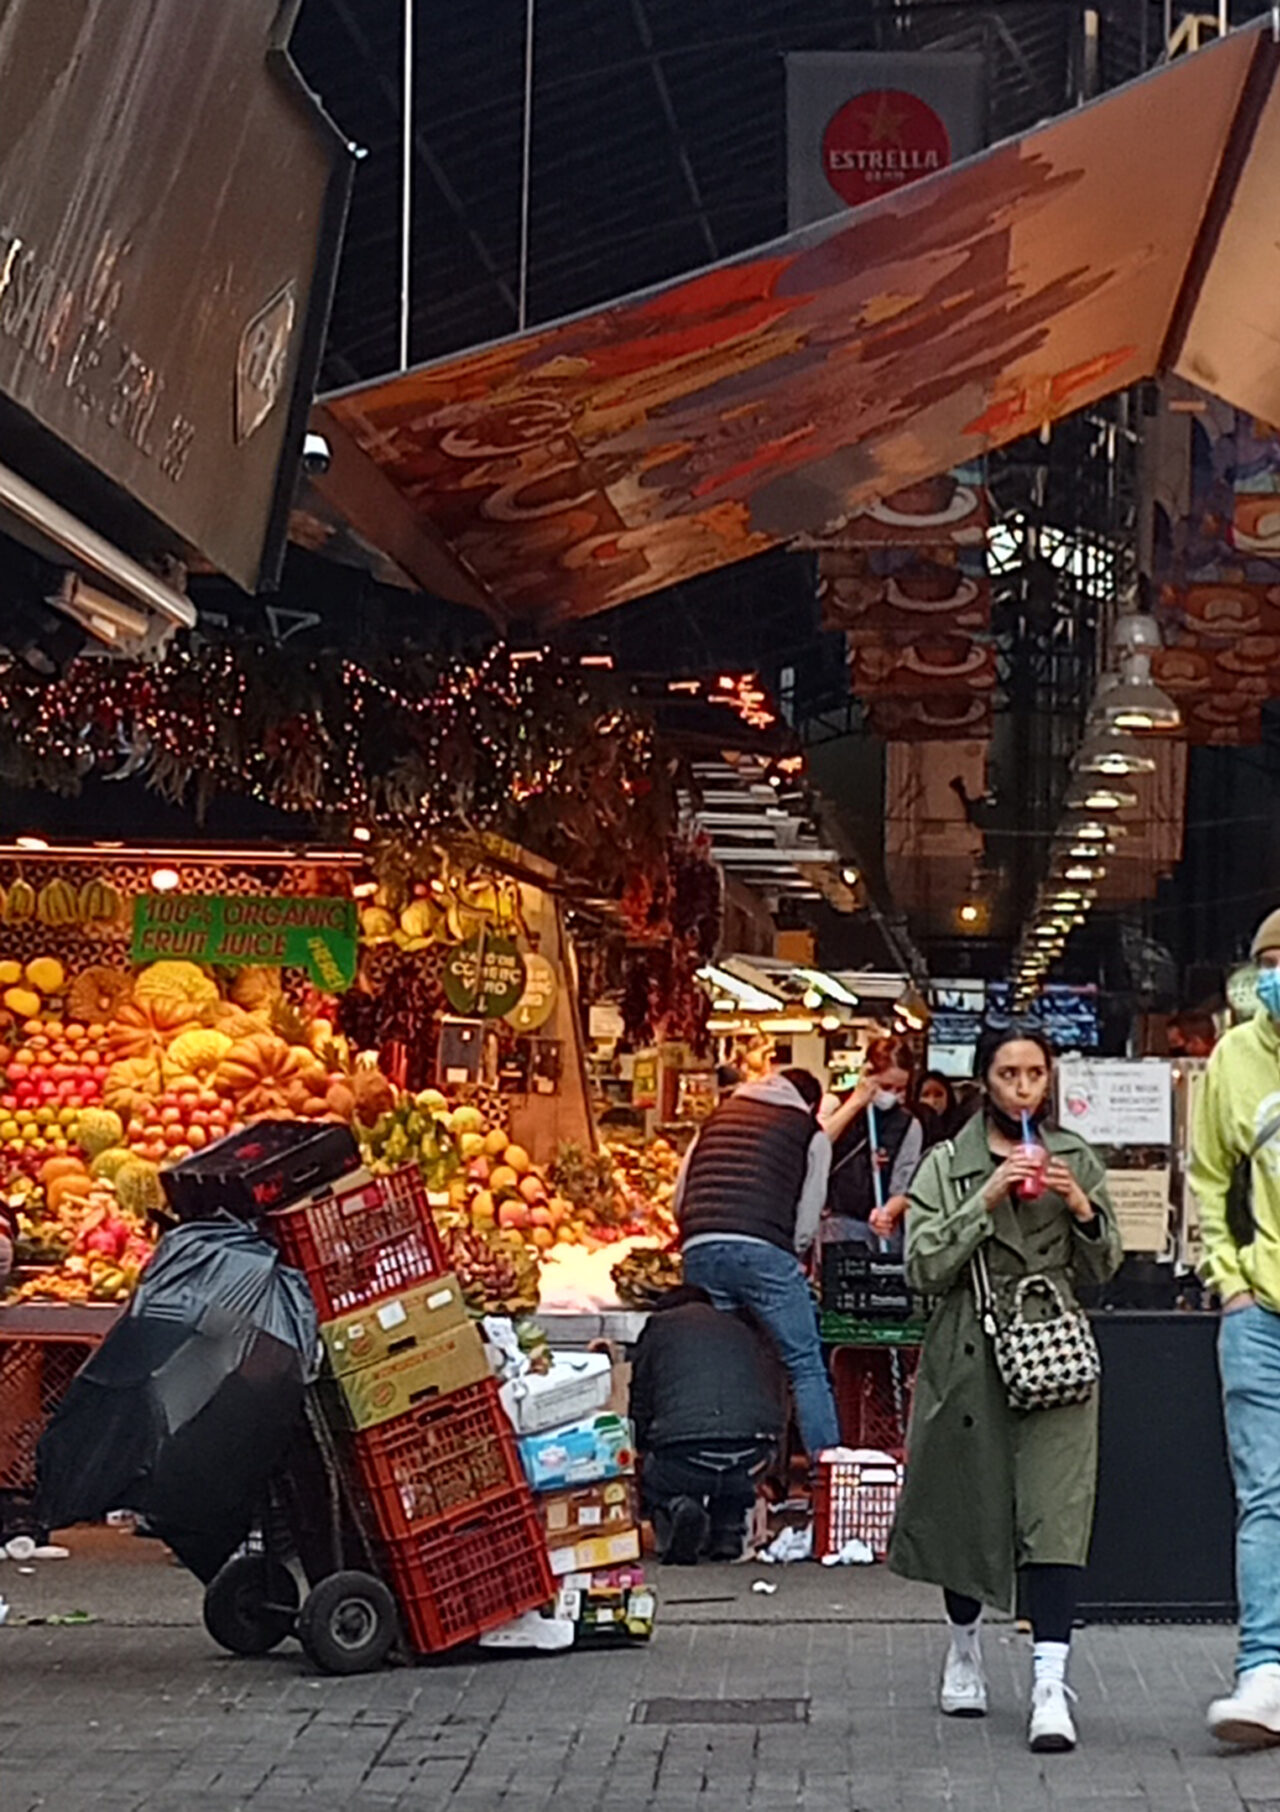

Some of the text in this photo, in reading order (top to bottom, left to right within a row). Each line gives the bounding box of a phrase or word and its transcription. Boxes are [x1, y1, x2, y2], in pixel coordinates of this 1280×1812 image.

[829, 149, 939, 169] ESTRELLA
[147, 898, 347, 929] 100% ORGANIC
[142, 928, 287, 957] FRUIT JUICE
